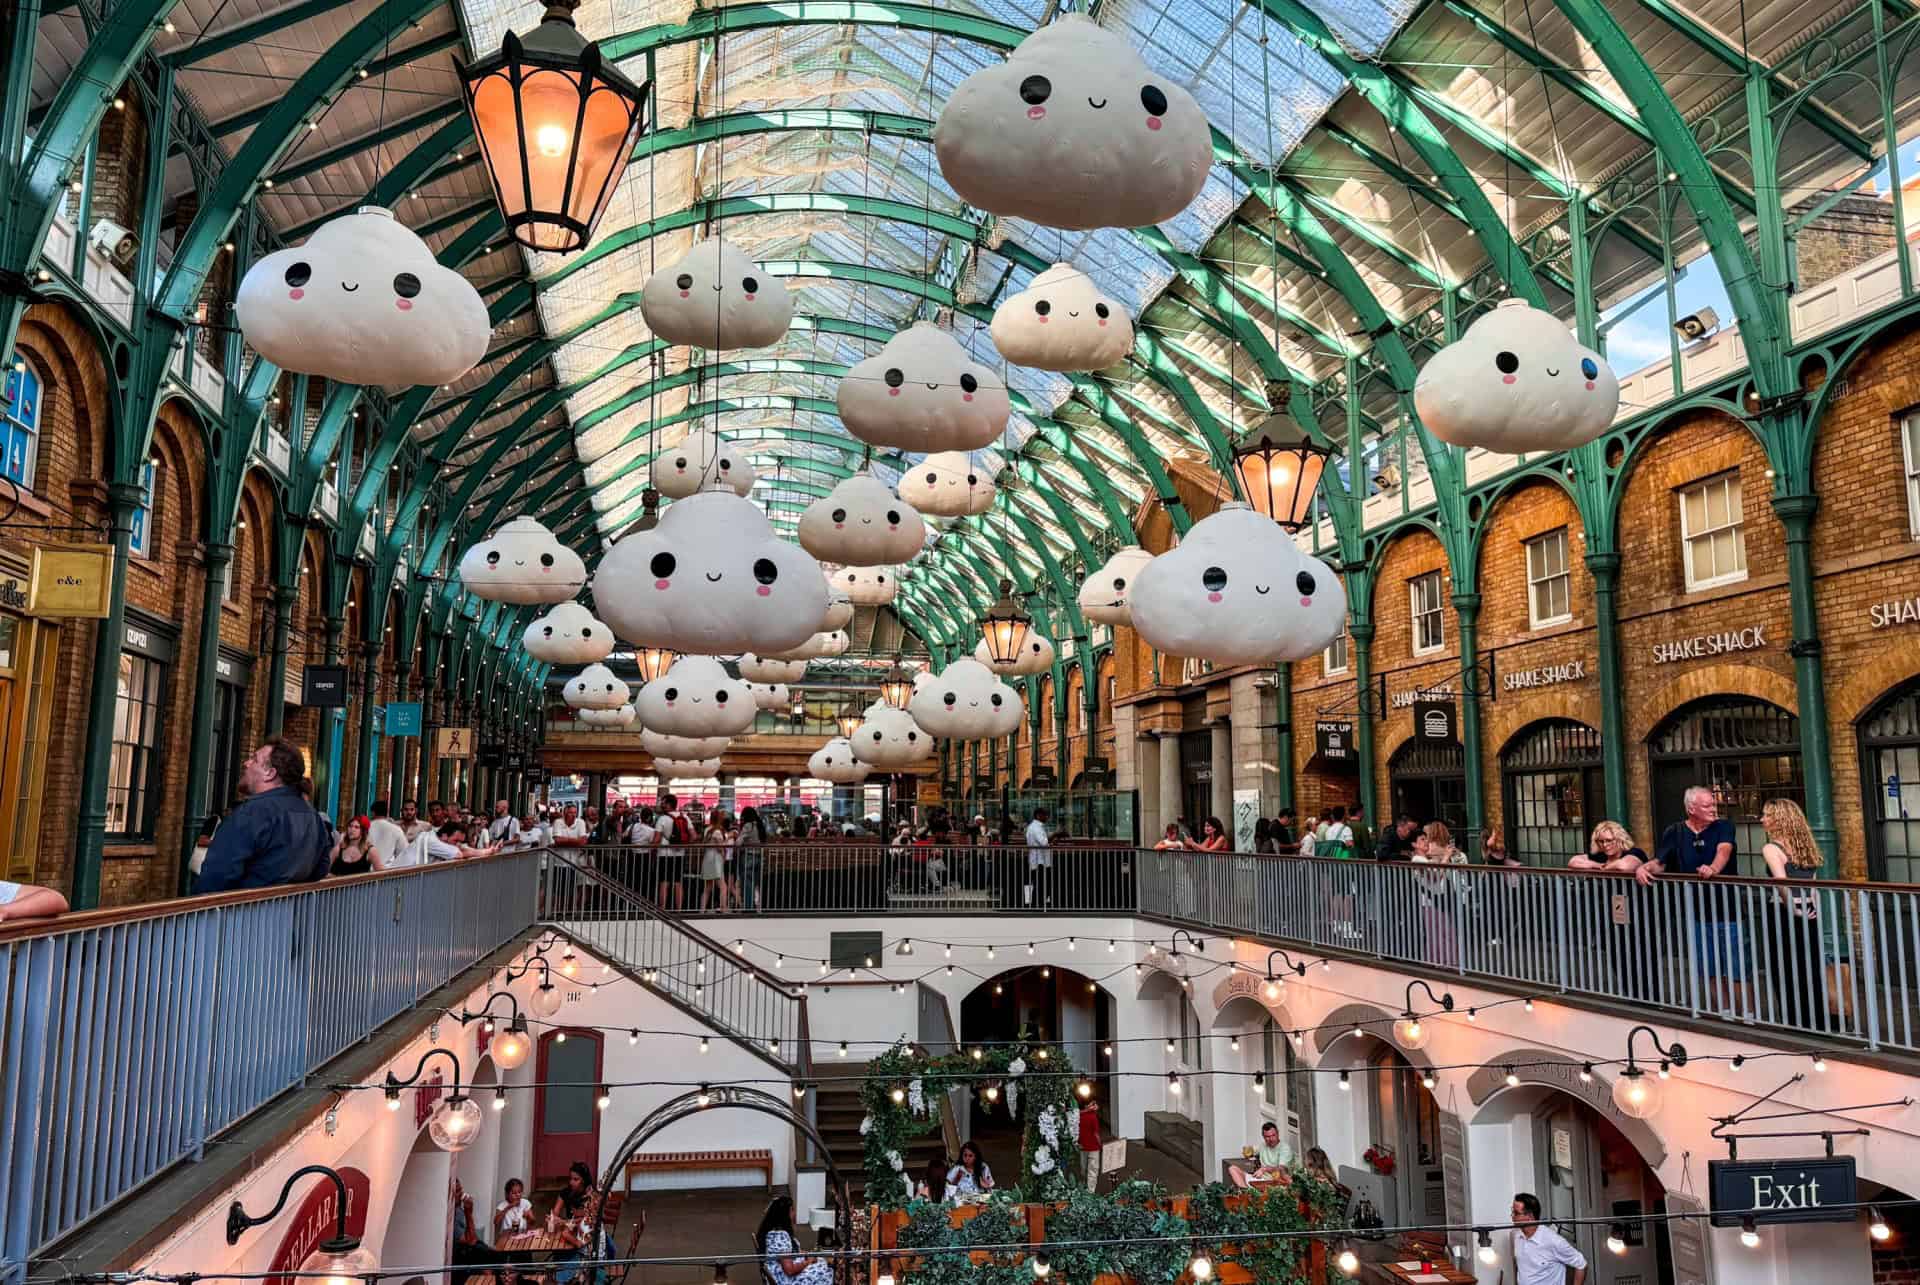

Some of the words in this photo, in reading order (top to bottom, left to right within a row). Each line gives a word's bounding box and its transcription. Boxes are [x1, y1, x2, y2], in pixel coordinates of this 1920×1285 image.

[1653, 637, 1706, 664] SHAKE
[1707, 625, 1767, 655] SHACK
[1504, 669, 1541, 690] SHAKE
[1542, 661, 1585, 684] SHACK
[1317, 723, 1337, 732] PICK
[1339, 723, 1352, 732] UP
[1325, 749, 1346, 758] HERE
[1750, 1172, 1822, 1210] Exit
